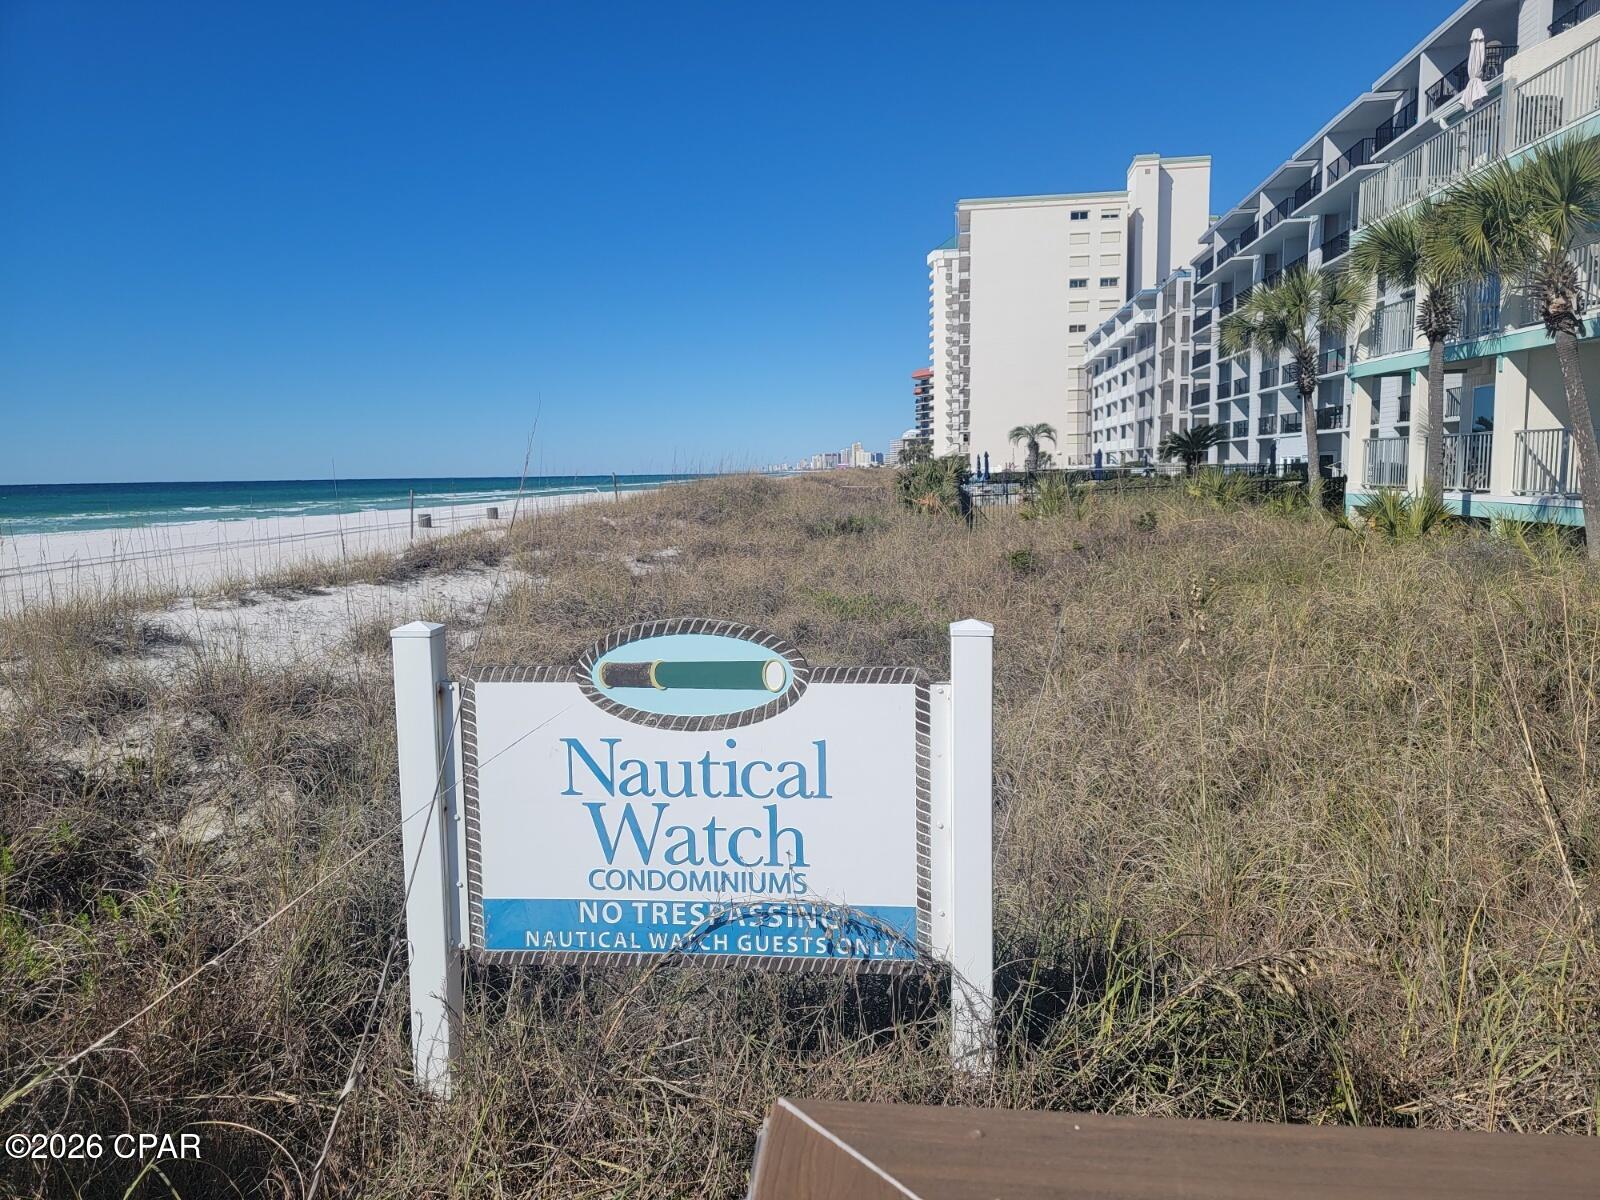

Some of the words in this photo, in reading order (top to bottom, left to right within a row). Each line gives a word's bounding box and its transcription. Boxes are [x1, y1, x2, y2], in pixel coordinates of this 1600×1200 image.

[560, 738, 833, 799] Nautical
[583, 802, 811, 868] Watch
[588, 869, 808, 894] CONDOMINIUMS
[579, 901, 623, 924] NO
[526, 930, 641, 949] NAUTICAL
[737, 934, 827, 954] GUESTS
[836, 937, 897, 956] ONLY
